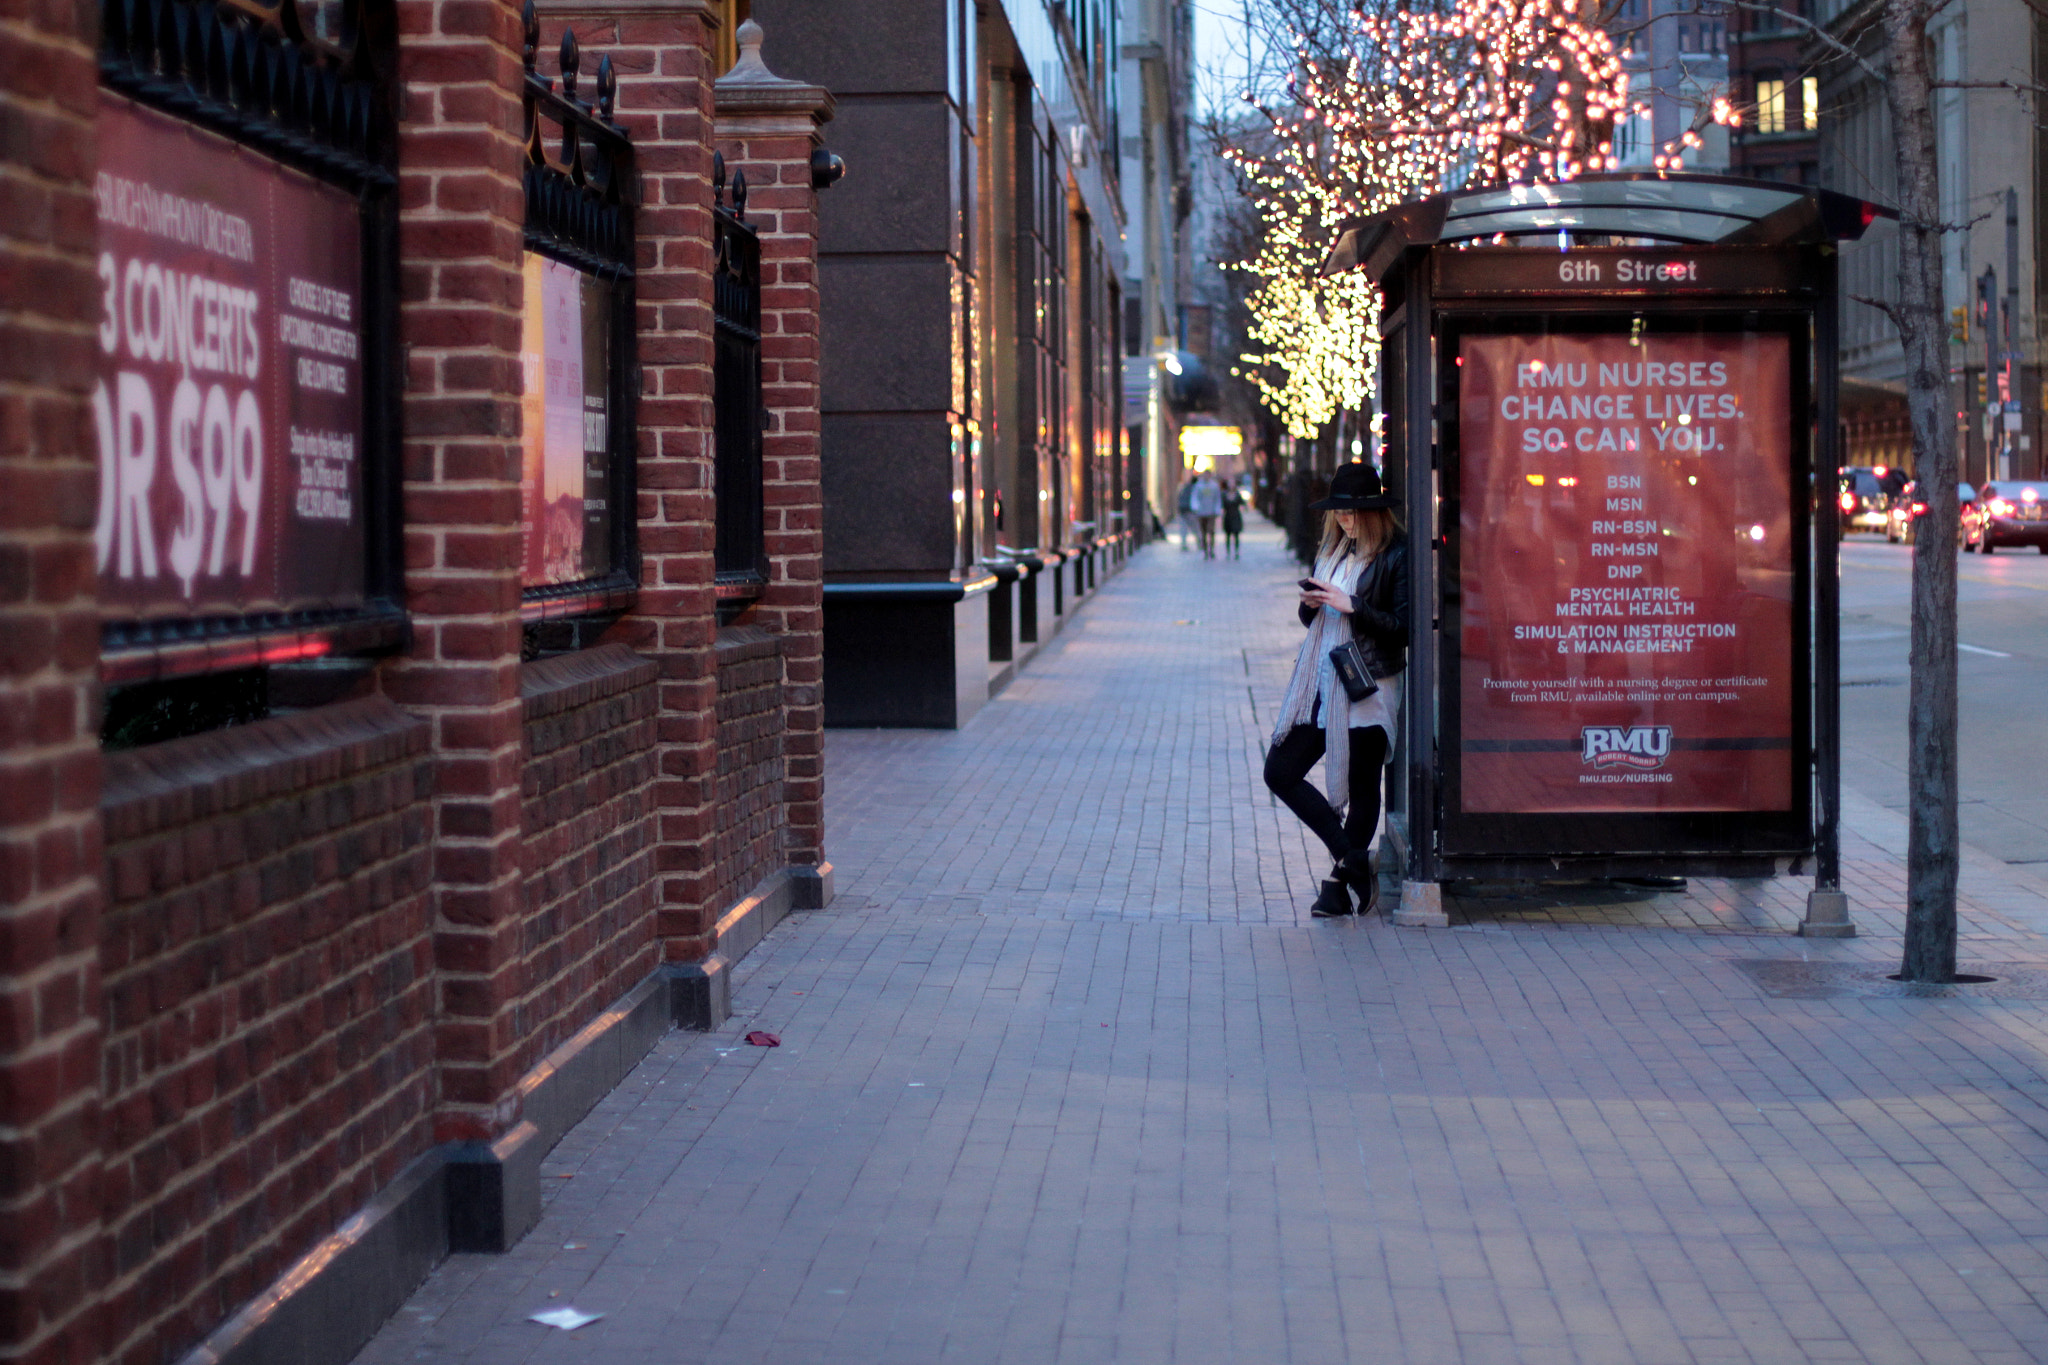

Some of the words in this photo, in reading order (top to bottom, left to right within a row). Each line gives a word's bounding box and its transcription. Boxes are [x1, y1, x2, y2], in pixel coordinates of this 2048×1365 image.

[142, 182, 200, 246] SYMPHONY
[201, 202, 253, 264] ORCHESTRA
[1559, 260, 1601, 282] 6th
[1616, 259, 1697, 282] Street
[98, 252, 118, 353] 3
[124, 258, 259, 381] CONCERTS
[1518, 363, 1587, 387] RMU
[1599, 362, 1727, 386] NURSES
[1501, 395, 1634, 420] CHANGE
[1645, 394, 1744, 420] LIVES.
[1523, 427, 1565, 452] SO
[1575, 427, 1640, 452] CAN
[1651, 426, 1724, 452] YOU.
[169, 364, 263, 598] $99
[1607, 475, 1641, 489] BSN
[1606, 498, 1643, 511] MSN
[1592, 520, 1657, 534] RN-BSN
[1591, 543, 1658, 556] RN-MSN
[1608, 565, 1643, 578] DNP
[1570, 587, 1681, 601] PSYCHIATRIC
[1556, 603, 1624, 617] MENTAL
[1629, 602, 1695, 616] HEALTH
[1514, 625, 1618, 639] SIMULATION
[1623, 624, 1736, 638] INSTRUCTION
[1557, 640, 1569, 654] &
[1574, 639, 1694, 653] MANAGEMENT
[1483, 678, 1529, 689] Promote
[1532, 677, 1577, 691] yourself
[1580, 676, 1605, 688] with
[1607, 679, 1614, 688] a
[1616, 677, 1659, 690] nursing
[1661, 677, 1698, 690] degree
[1700, 679, 1713, 687] or
[1715, 675, 1768, 686] certificate
[1511, 692, 1537, 702] from
[1540, 691, 1573, 703] RMU,
[1575, 691, 1624, 702] available
[1627, 690, 1661, 701] online
[1663, 692, 1676, 701] or
[1678, 692, 1692, 701] on
[1694, 691, 1740, 703] campus.
[1584, 729, 1669, 760] RMU
[1598, 752, 1628, 763] ROBERT
[1628, 755, 1658, 766] MORRIS
[1580, 774, 1673, 783] RMU.EDU/NURSING
